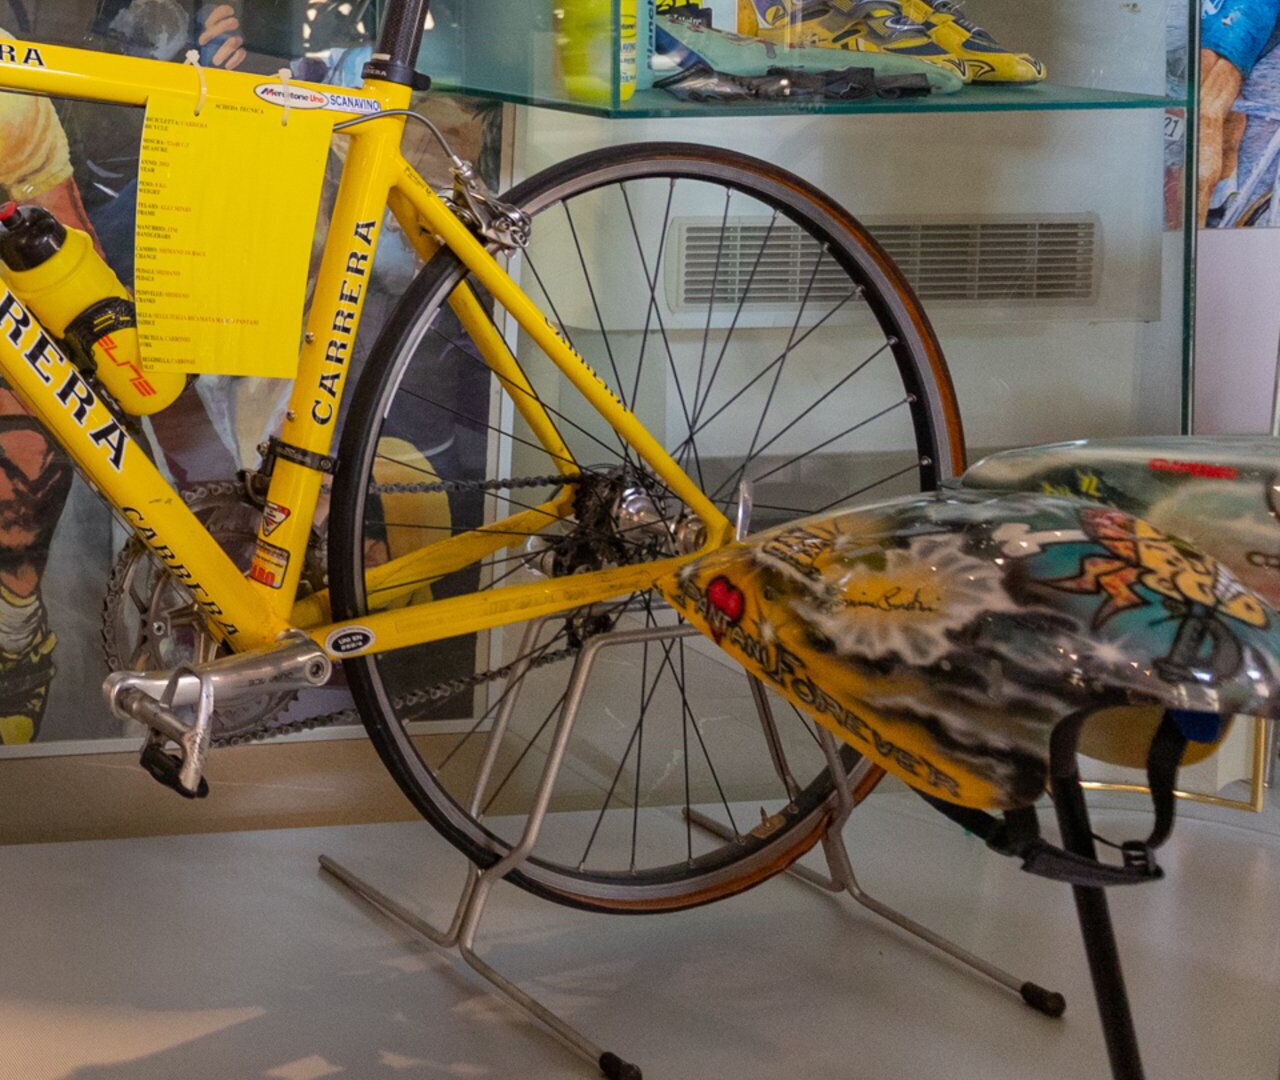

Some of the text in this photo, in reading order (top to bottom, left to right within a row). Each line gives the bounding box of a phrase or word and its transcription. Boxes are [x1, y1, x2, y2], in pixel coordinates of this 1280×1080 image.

[309, 93, 325, 104] Uno
[329, 94, 381, 112] SCANAVINO
[311, 219, 377, 426] CARRERA
